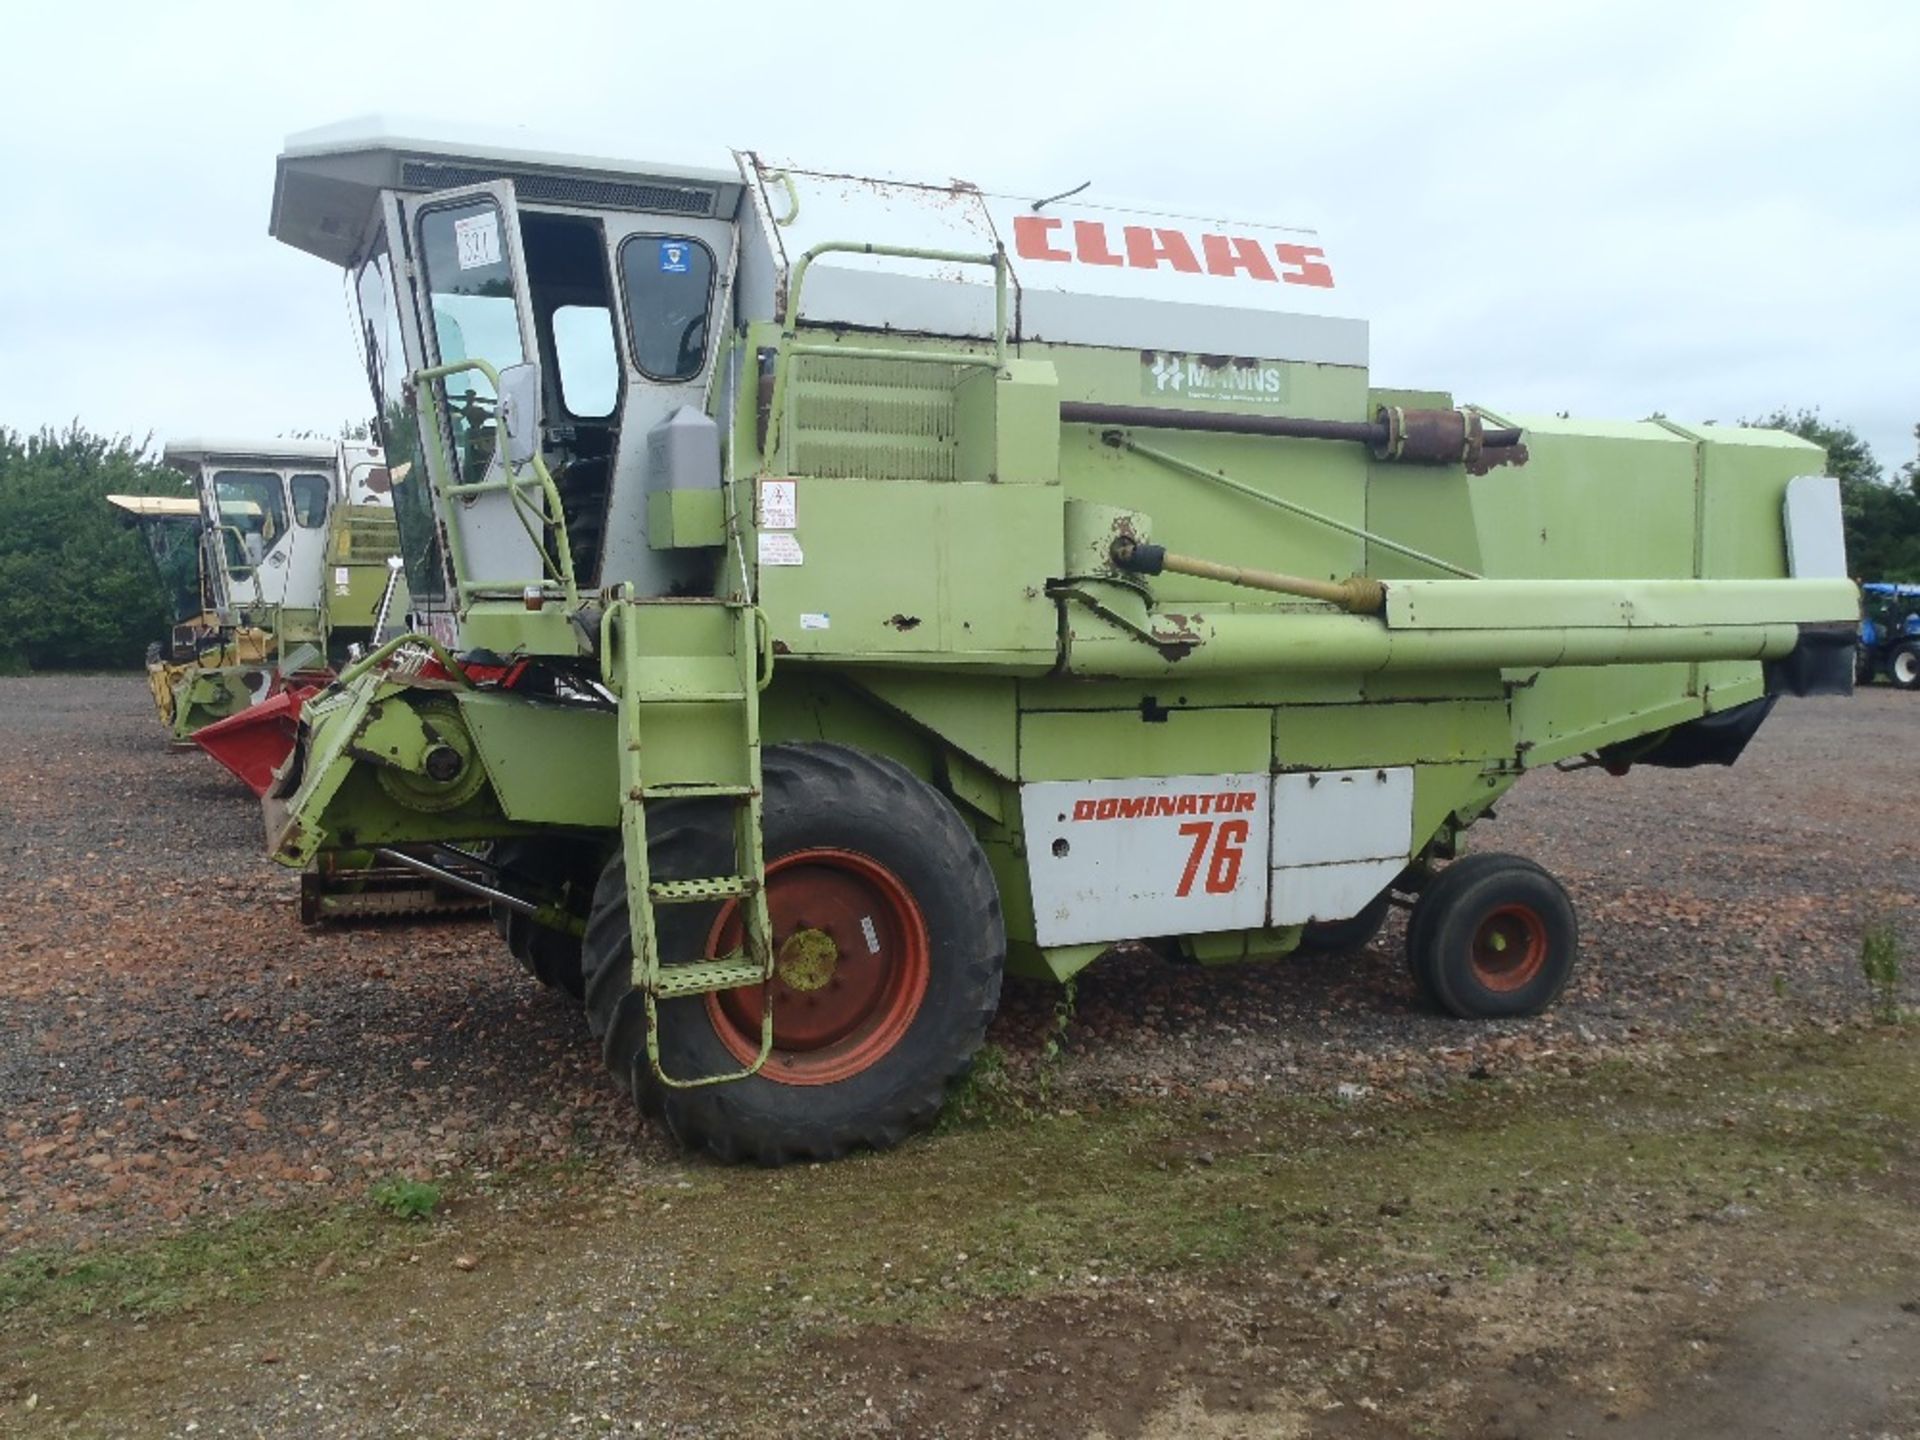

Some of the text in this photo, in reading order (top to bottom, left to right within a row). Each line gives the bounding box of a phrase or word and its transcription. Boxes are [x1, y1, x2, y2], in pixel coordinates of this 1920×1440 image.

[1014, 217, 1334, 288] CLAAS
[1073, 793, 1256, 821] DOMINATOR
[1176, 820, 1249, 897] 76
